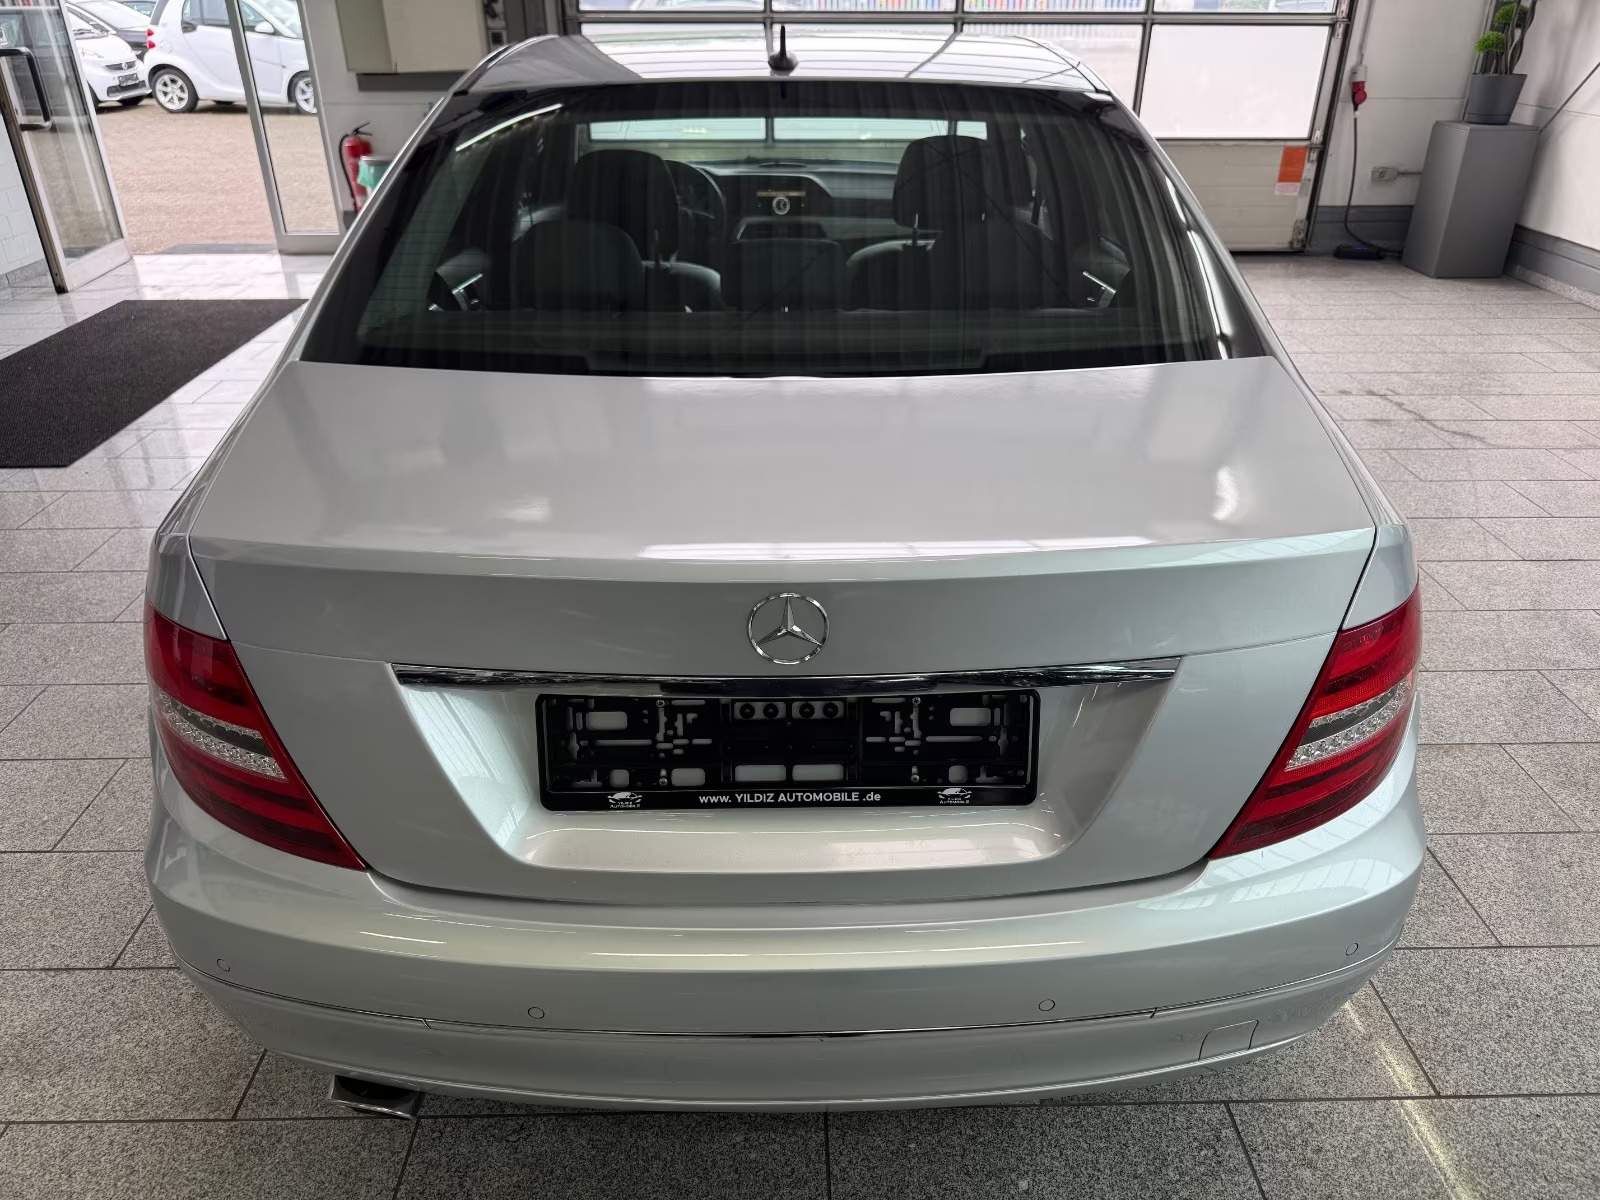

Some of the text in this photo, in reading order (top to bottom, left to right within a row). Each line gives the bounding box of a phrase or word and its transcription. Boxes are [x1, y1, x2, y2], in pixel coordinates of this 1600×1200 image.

[699, 791, 881, 804] www. YILDIZ AUTOMOBILE .de
